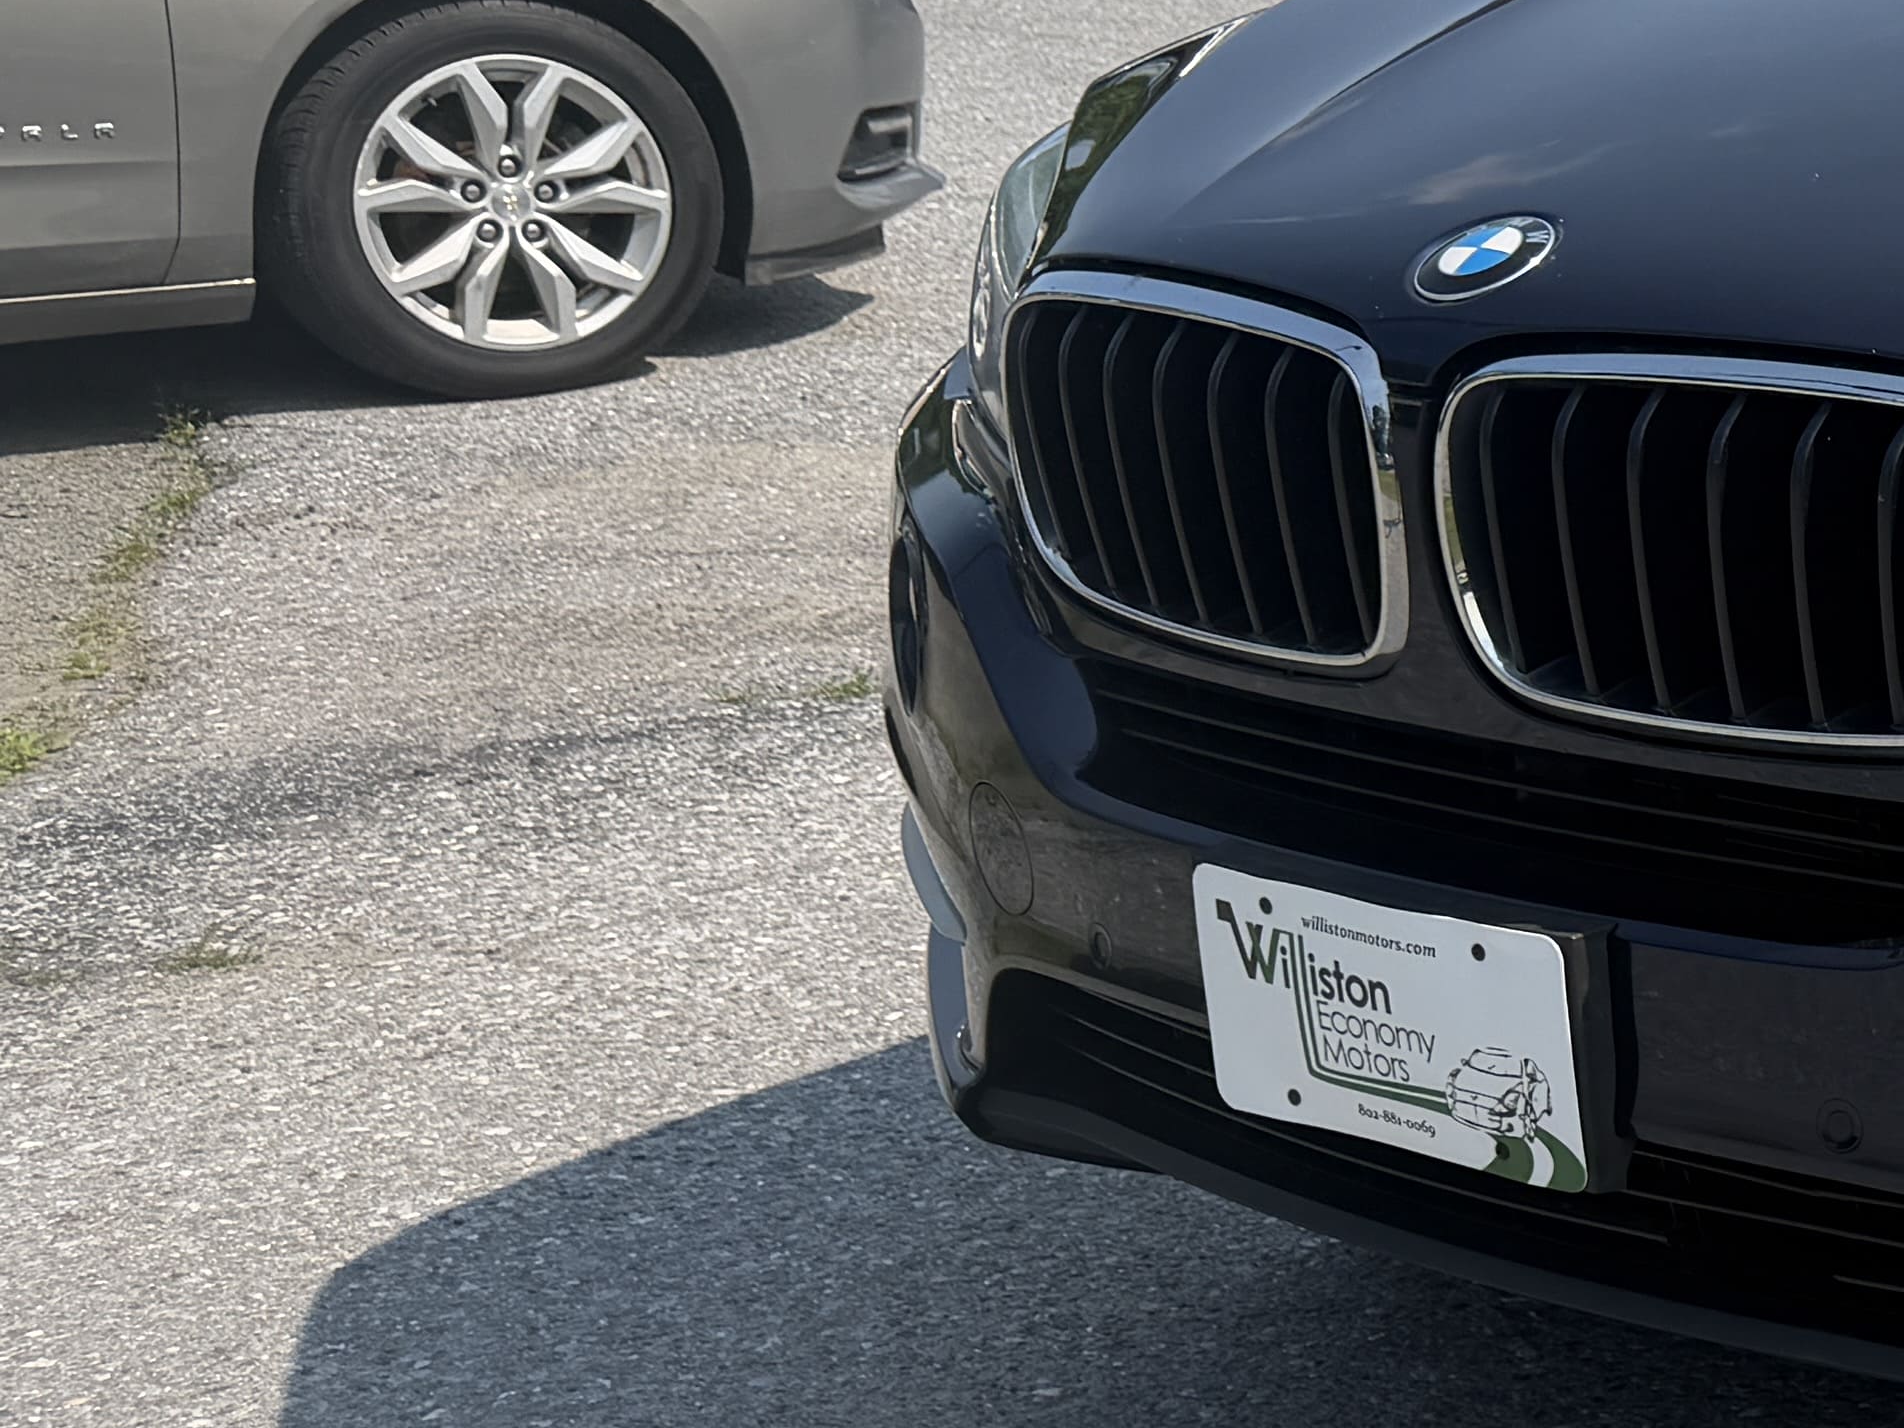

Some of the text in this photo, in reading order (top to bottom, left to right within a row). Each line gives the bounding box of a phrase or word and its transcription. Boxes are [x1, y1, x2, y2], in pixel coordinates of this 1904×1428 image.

[0, 122, 116, 141] ALA
[1215, 898, 1392, 1014] Williston
[1301, 915, 1436, 959] willistonmotors.com
[1316, 1001, 1436, 1063] Economy
[1322, 1034, 1410, 1083] Motors
[1357, 1103, 1436, 1138] 802-881-0069
